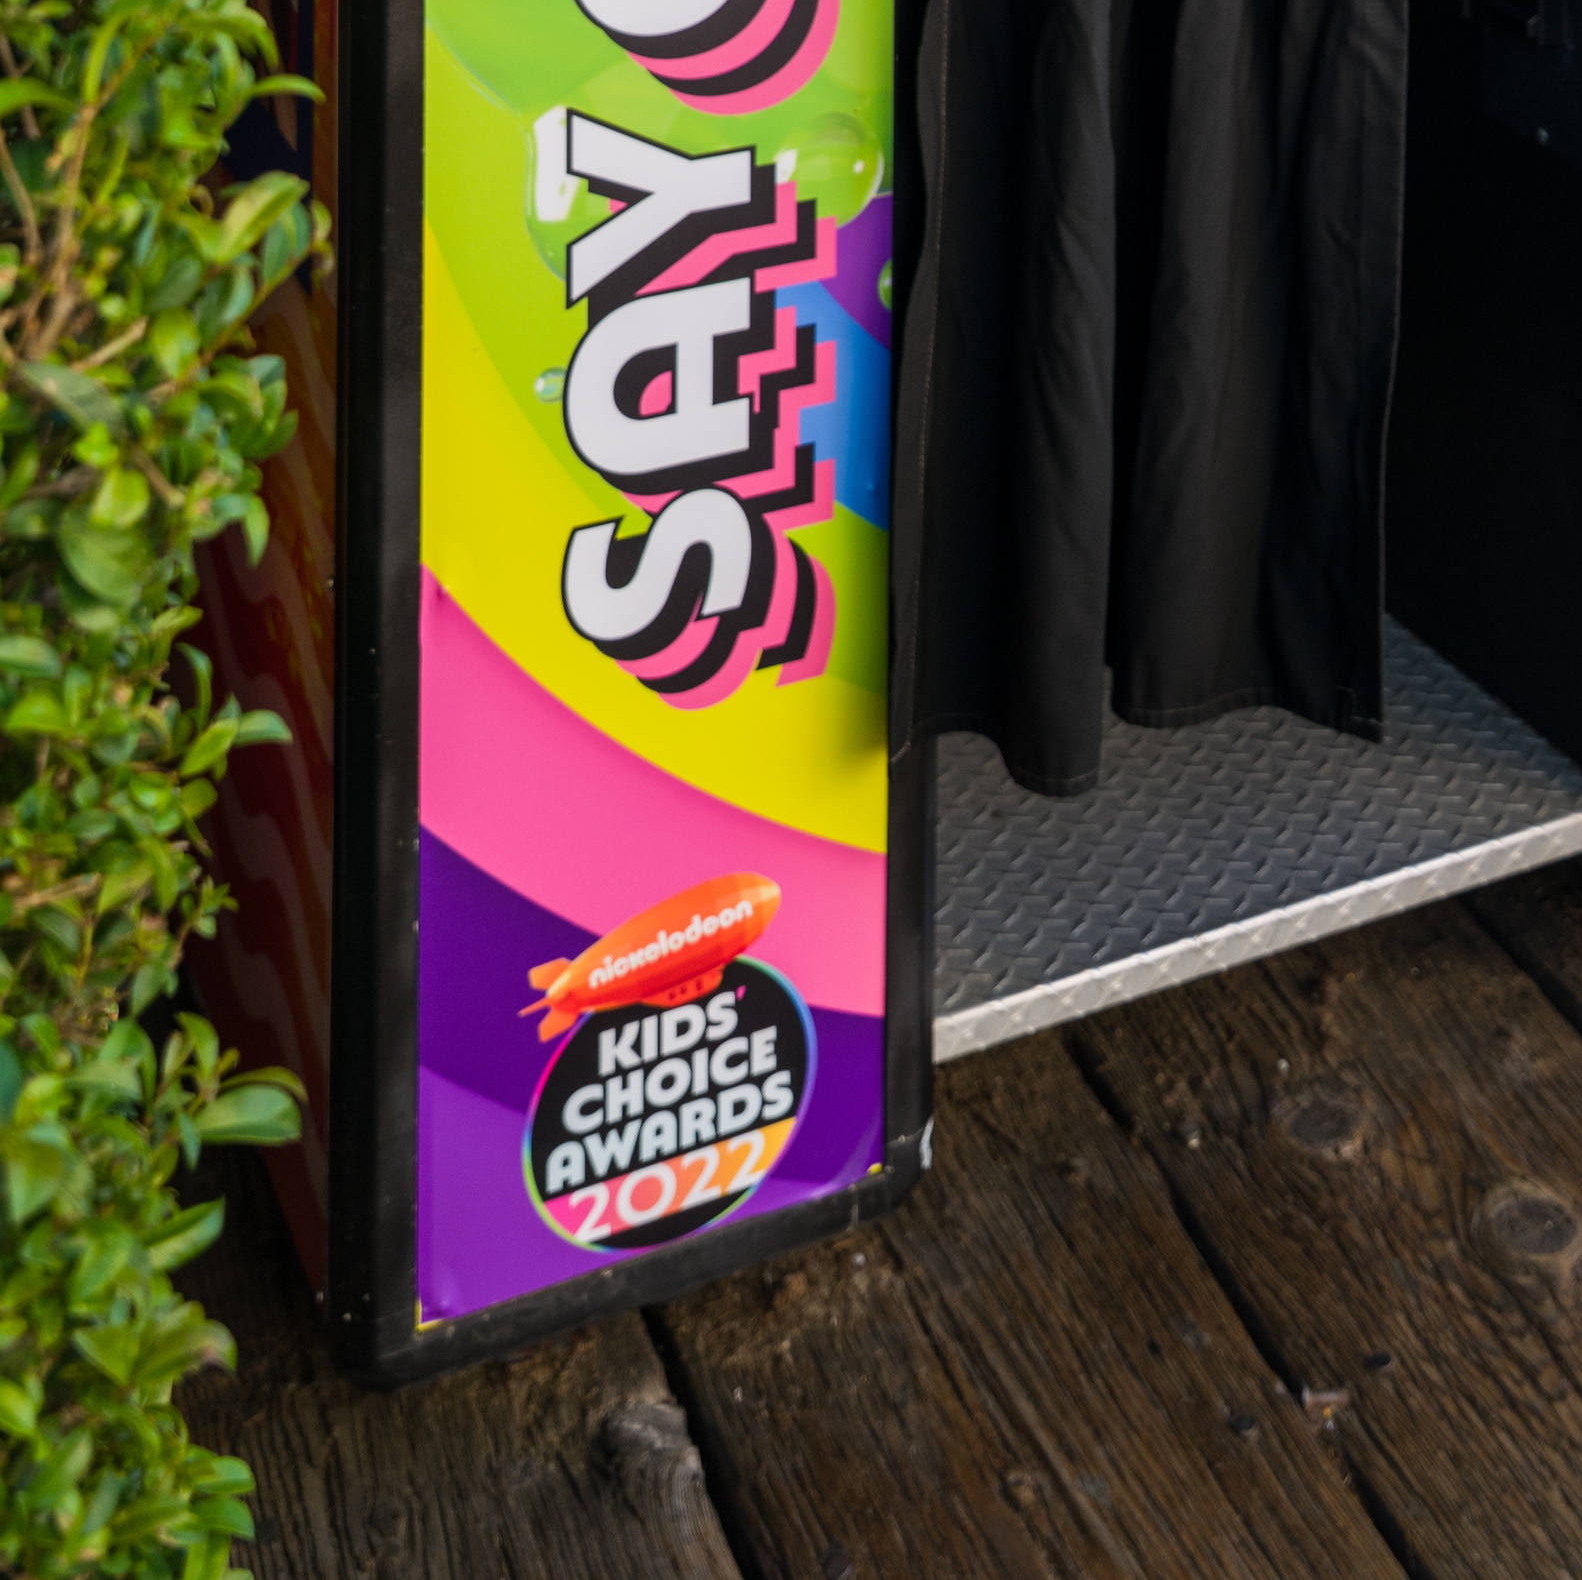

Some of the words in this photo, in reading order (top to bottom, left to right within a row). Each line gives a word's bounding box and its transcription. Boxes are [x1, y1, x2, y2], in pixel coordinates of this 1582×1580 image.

[563, 105, 780, 664] SAY
[588, 899, 754, 990] nickelodeon
[562, 1025, 778, 1135] CHOICE
[599, 985, 746, 1077] KIDS'
[545, 1070, 794, 1194] AWARDS
[568, 1129, 767, 1244] 2022
